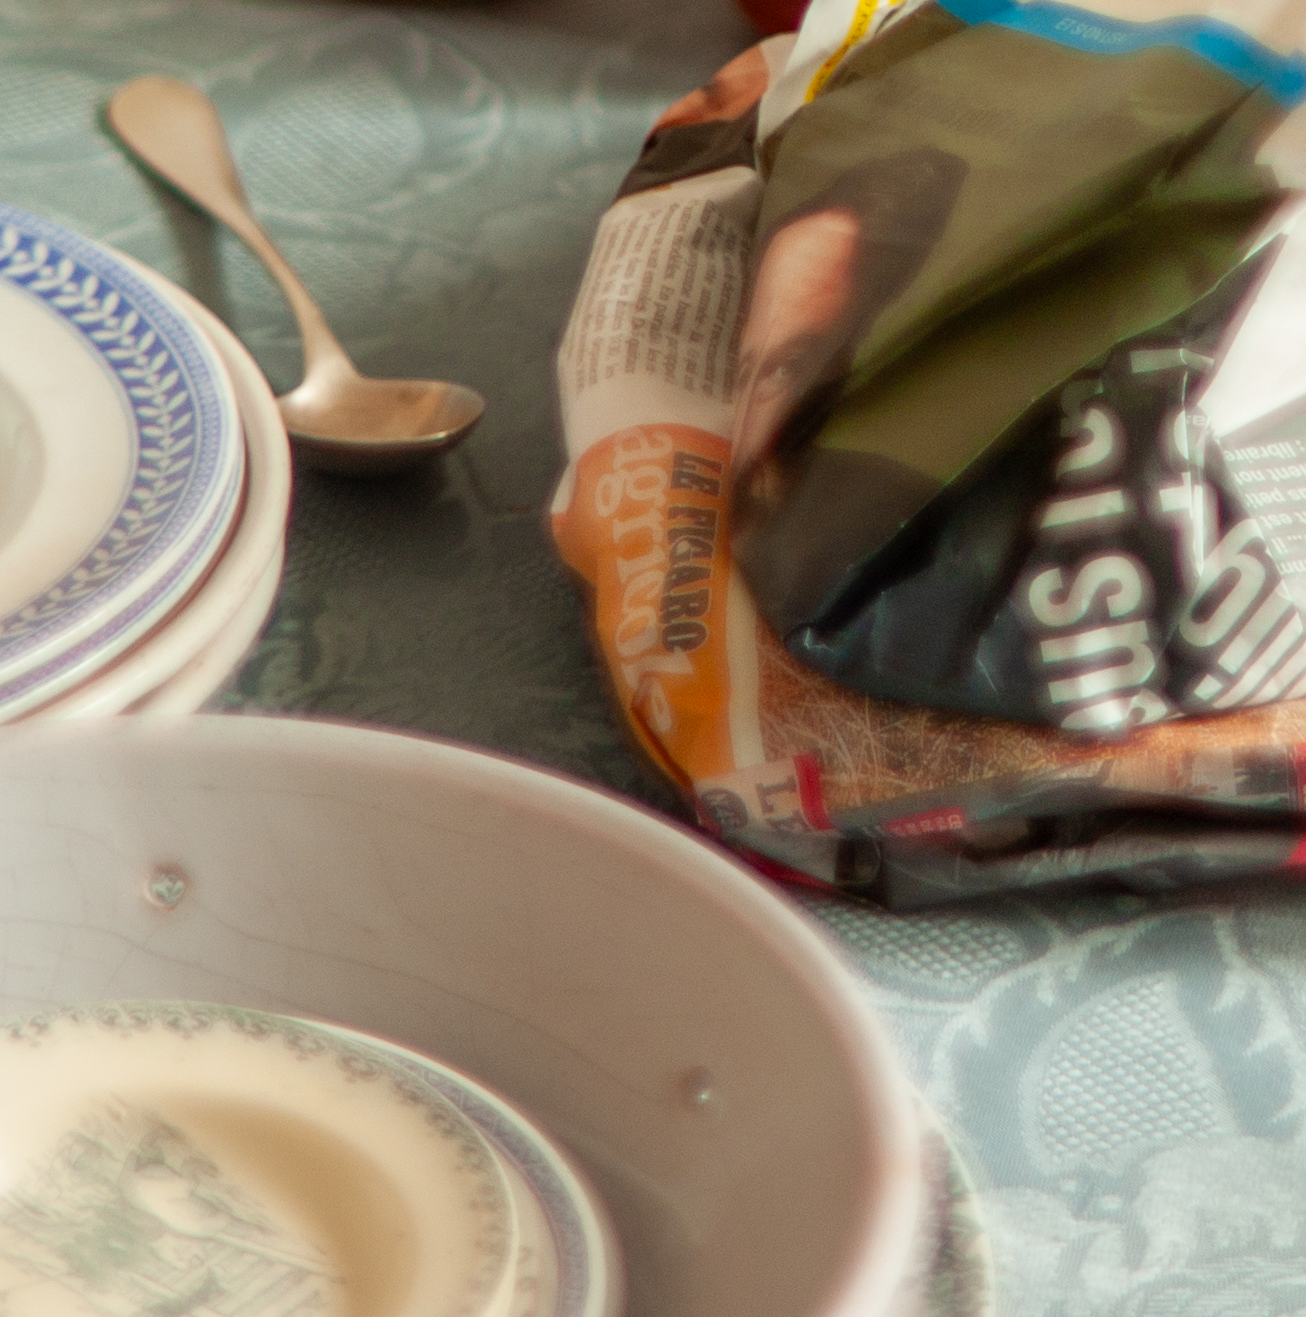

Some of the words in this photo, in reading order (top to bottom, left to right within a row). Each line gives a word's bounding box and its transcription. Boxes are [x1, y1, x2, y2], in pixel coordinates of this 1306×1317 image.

[670, 449, 723, 498] LE
[1259, 510, 1292, 531] est
[593, 426, 680, 734] agricole
[660, 498, 721, 652] FIGARO
